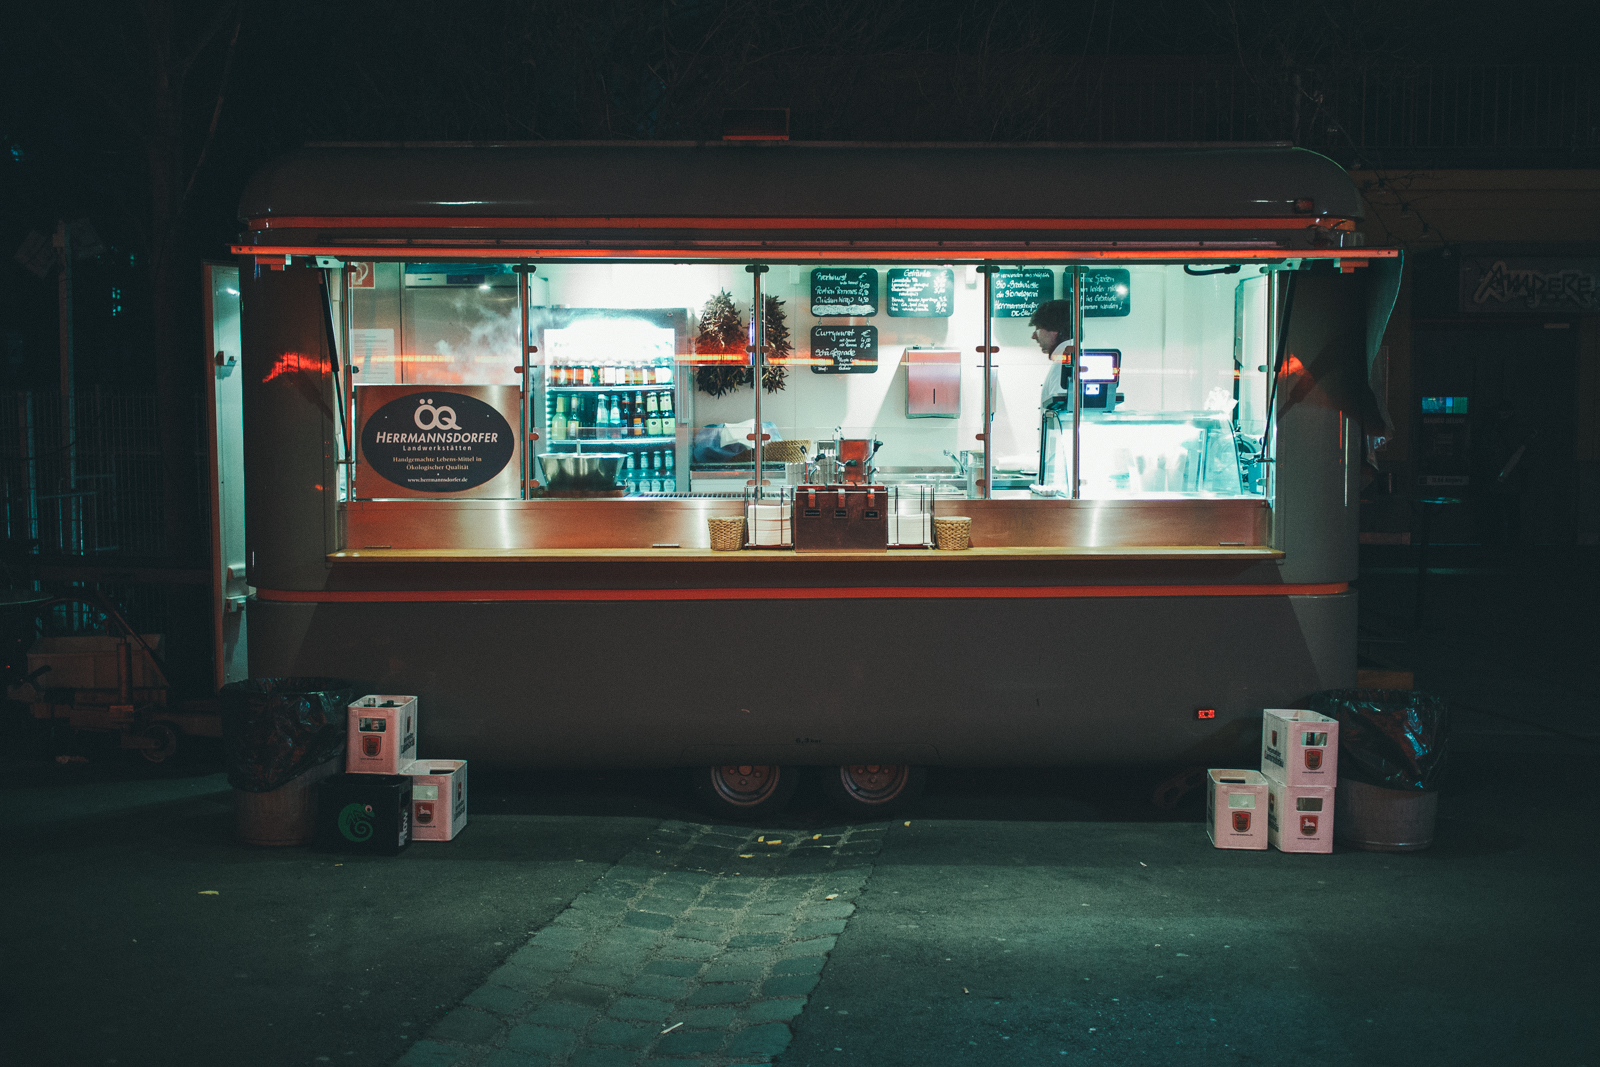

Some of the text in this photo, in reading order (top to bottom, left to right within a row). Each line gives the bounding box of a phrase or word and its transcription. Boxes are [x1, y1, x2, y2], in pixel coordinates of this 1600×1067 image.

[904, 269, 931, 277] Getränke
[815, 328, 855, 341] Currywurst
[376, 431, 498, 444] HERRMANNSDORFER
